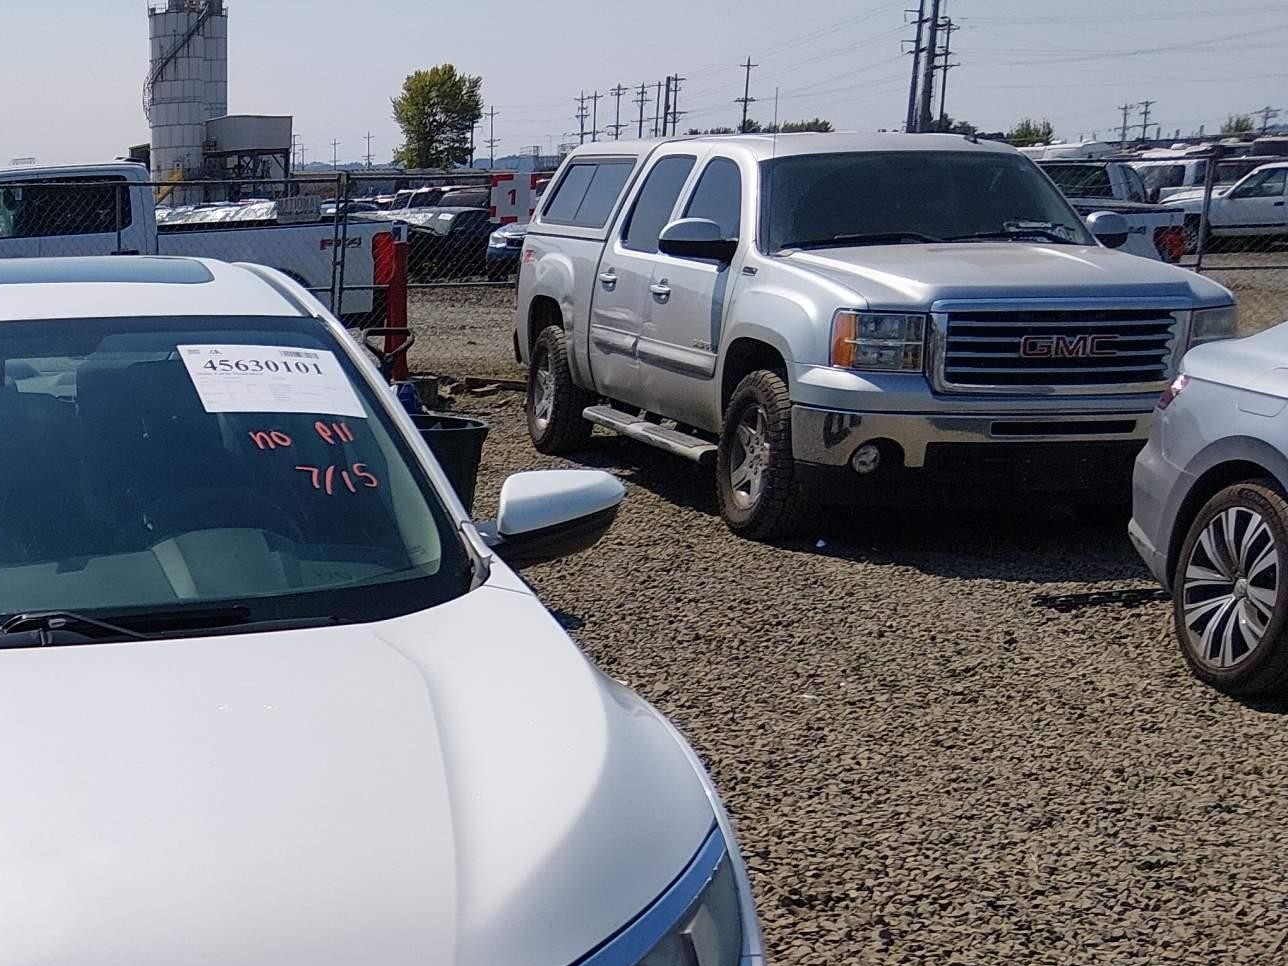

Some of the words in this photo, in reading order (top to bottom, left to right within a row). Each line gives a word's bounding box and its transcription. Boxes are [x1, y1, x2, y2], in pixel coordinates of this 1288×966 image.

[507, 190, 517, 206] 1
[1020, 335, 1120, 358] GMC
[203, 359, 323, 375] 45630101
[248, 430, 292, 449] no
[295, 463, 378, 495] 7/15
